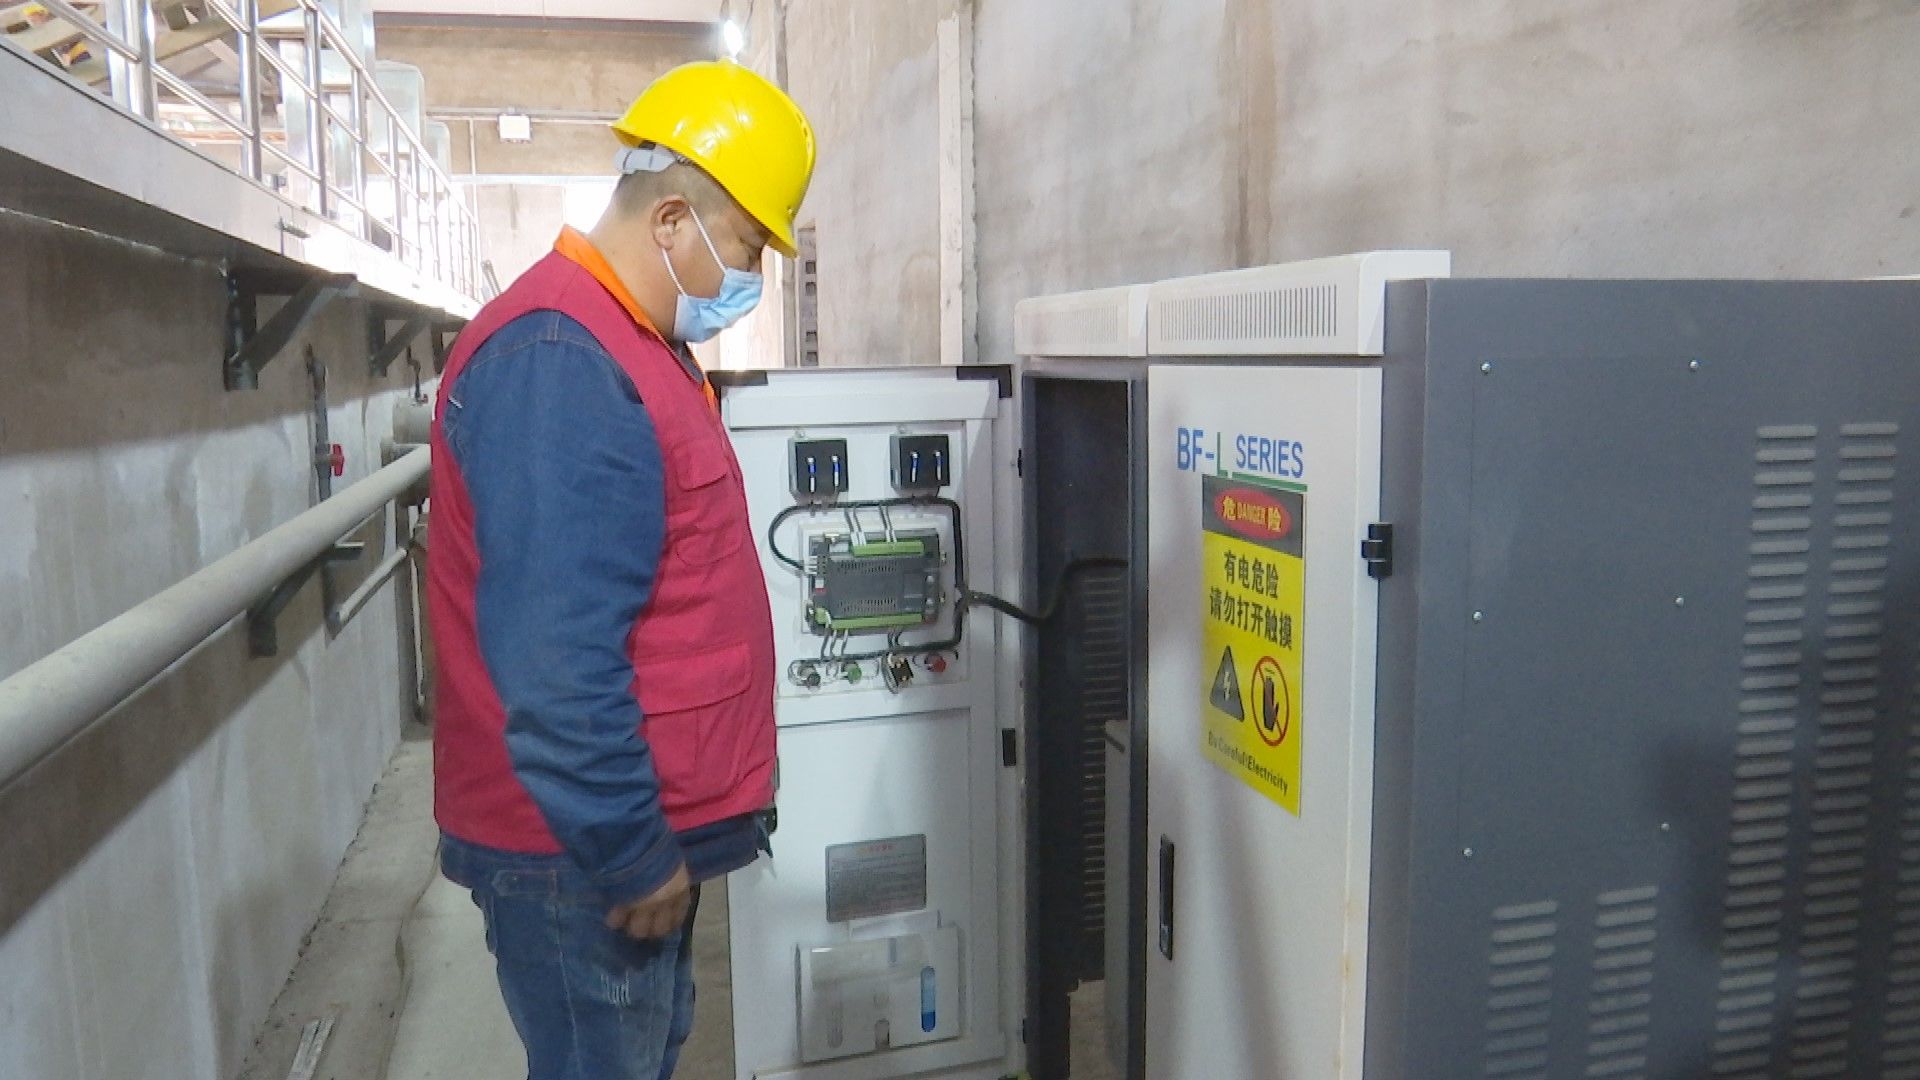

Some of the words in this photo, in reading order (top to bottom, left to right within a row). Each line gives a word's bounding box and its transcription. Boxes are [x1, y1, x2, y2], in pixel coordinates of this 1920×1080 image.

[1177, 427, 1228, 476] BF-L
[1235, 434, 1304, 478] SERIES
[1222, 495, 1236, 521] 危
[1236, 502, 1266, 525] DANGER
[1267, 506, 1282, 532] 险
[1224, 550, 1279, 600] 有电危险
[1210, 586, 1292, 651] 请勿打开触摸
